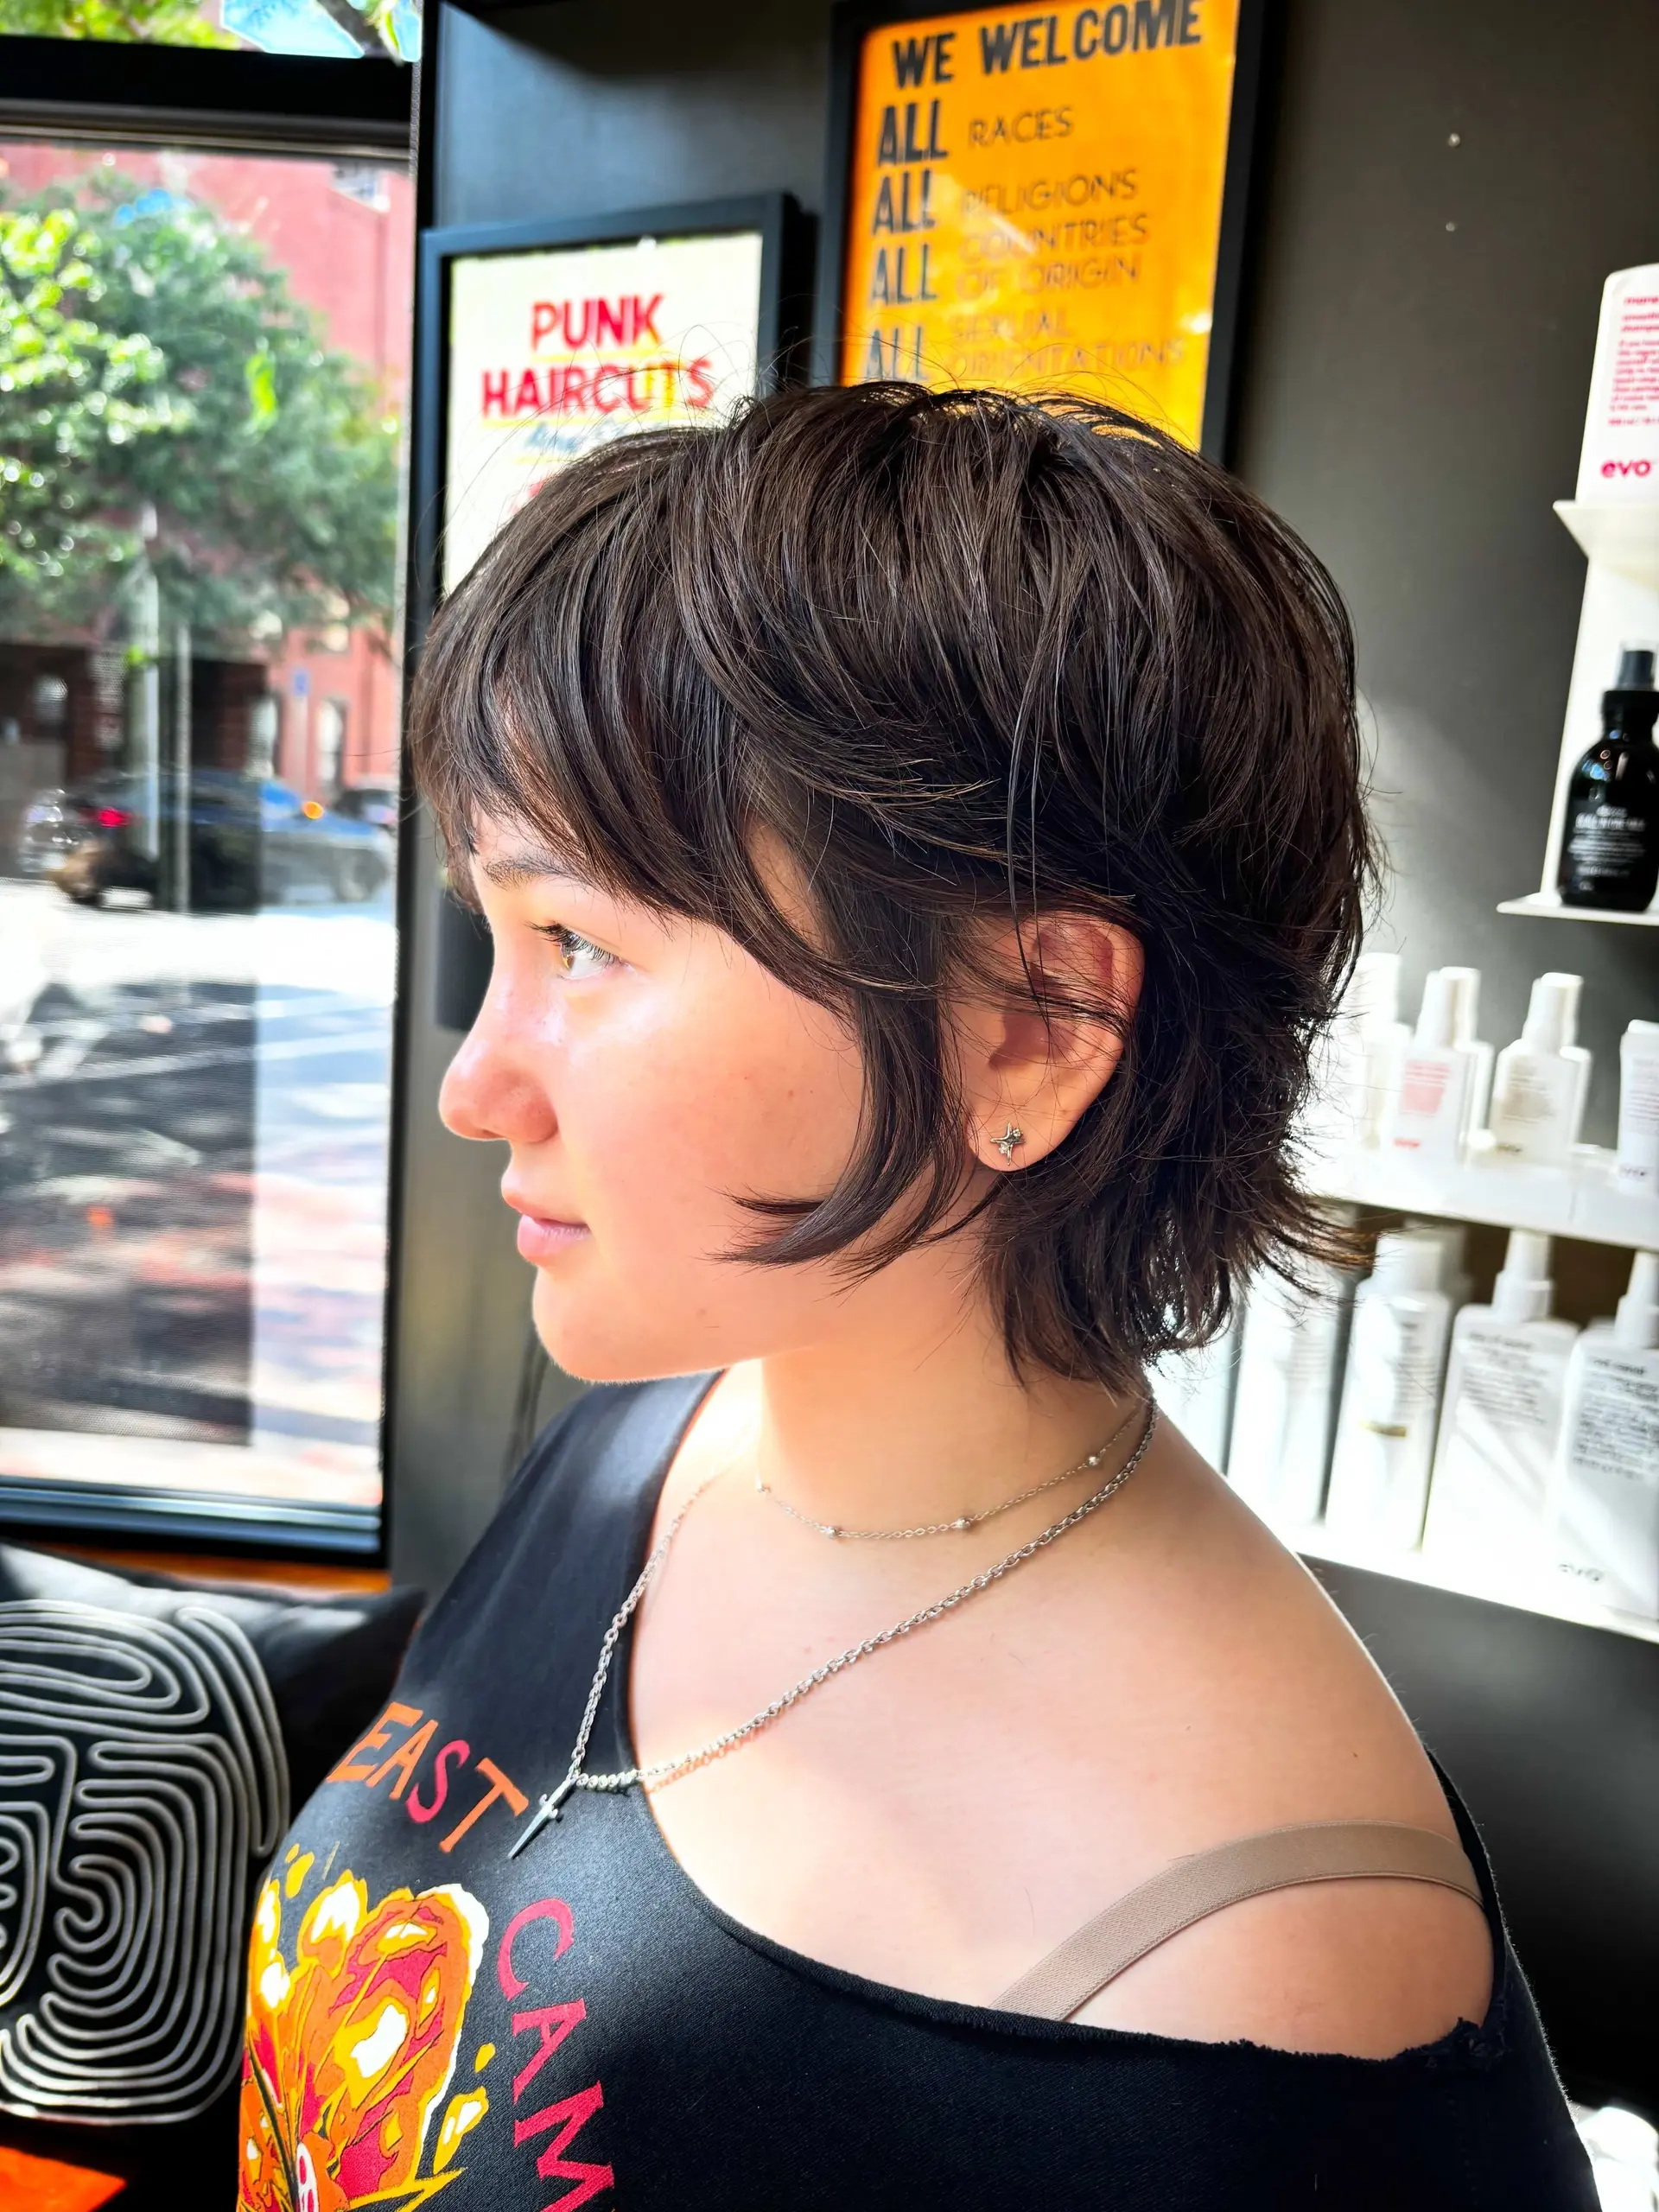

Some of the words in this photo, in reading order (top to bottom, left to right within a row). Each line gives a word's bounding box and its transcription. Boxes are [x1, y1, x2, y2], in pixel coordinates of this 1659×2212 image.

[892, 32, 956, 90] WE
[981, 0, 1204, 76] WELCOME
[878, 99, 948, 167] ALL
[968, 107, 1076, 149] RACES
[873, 169, 936, 236] ALL
[871, 243, 938, 305] ALL
[1018, 251, 1141, 296] ORIGIN
[530, 293, 665, 351] PUNK
[865, 326, 927, 381] ALL
[481, 358, 716, 419] HAIRCUTS
[1600, 459, 1651, 479] evo
